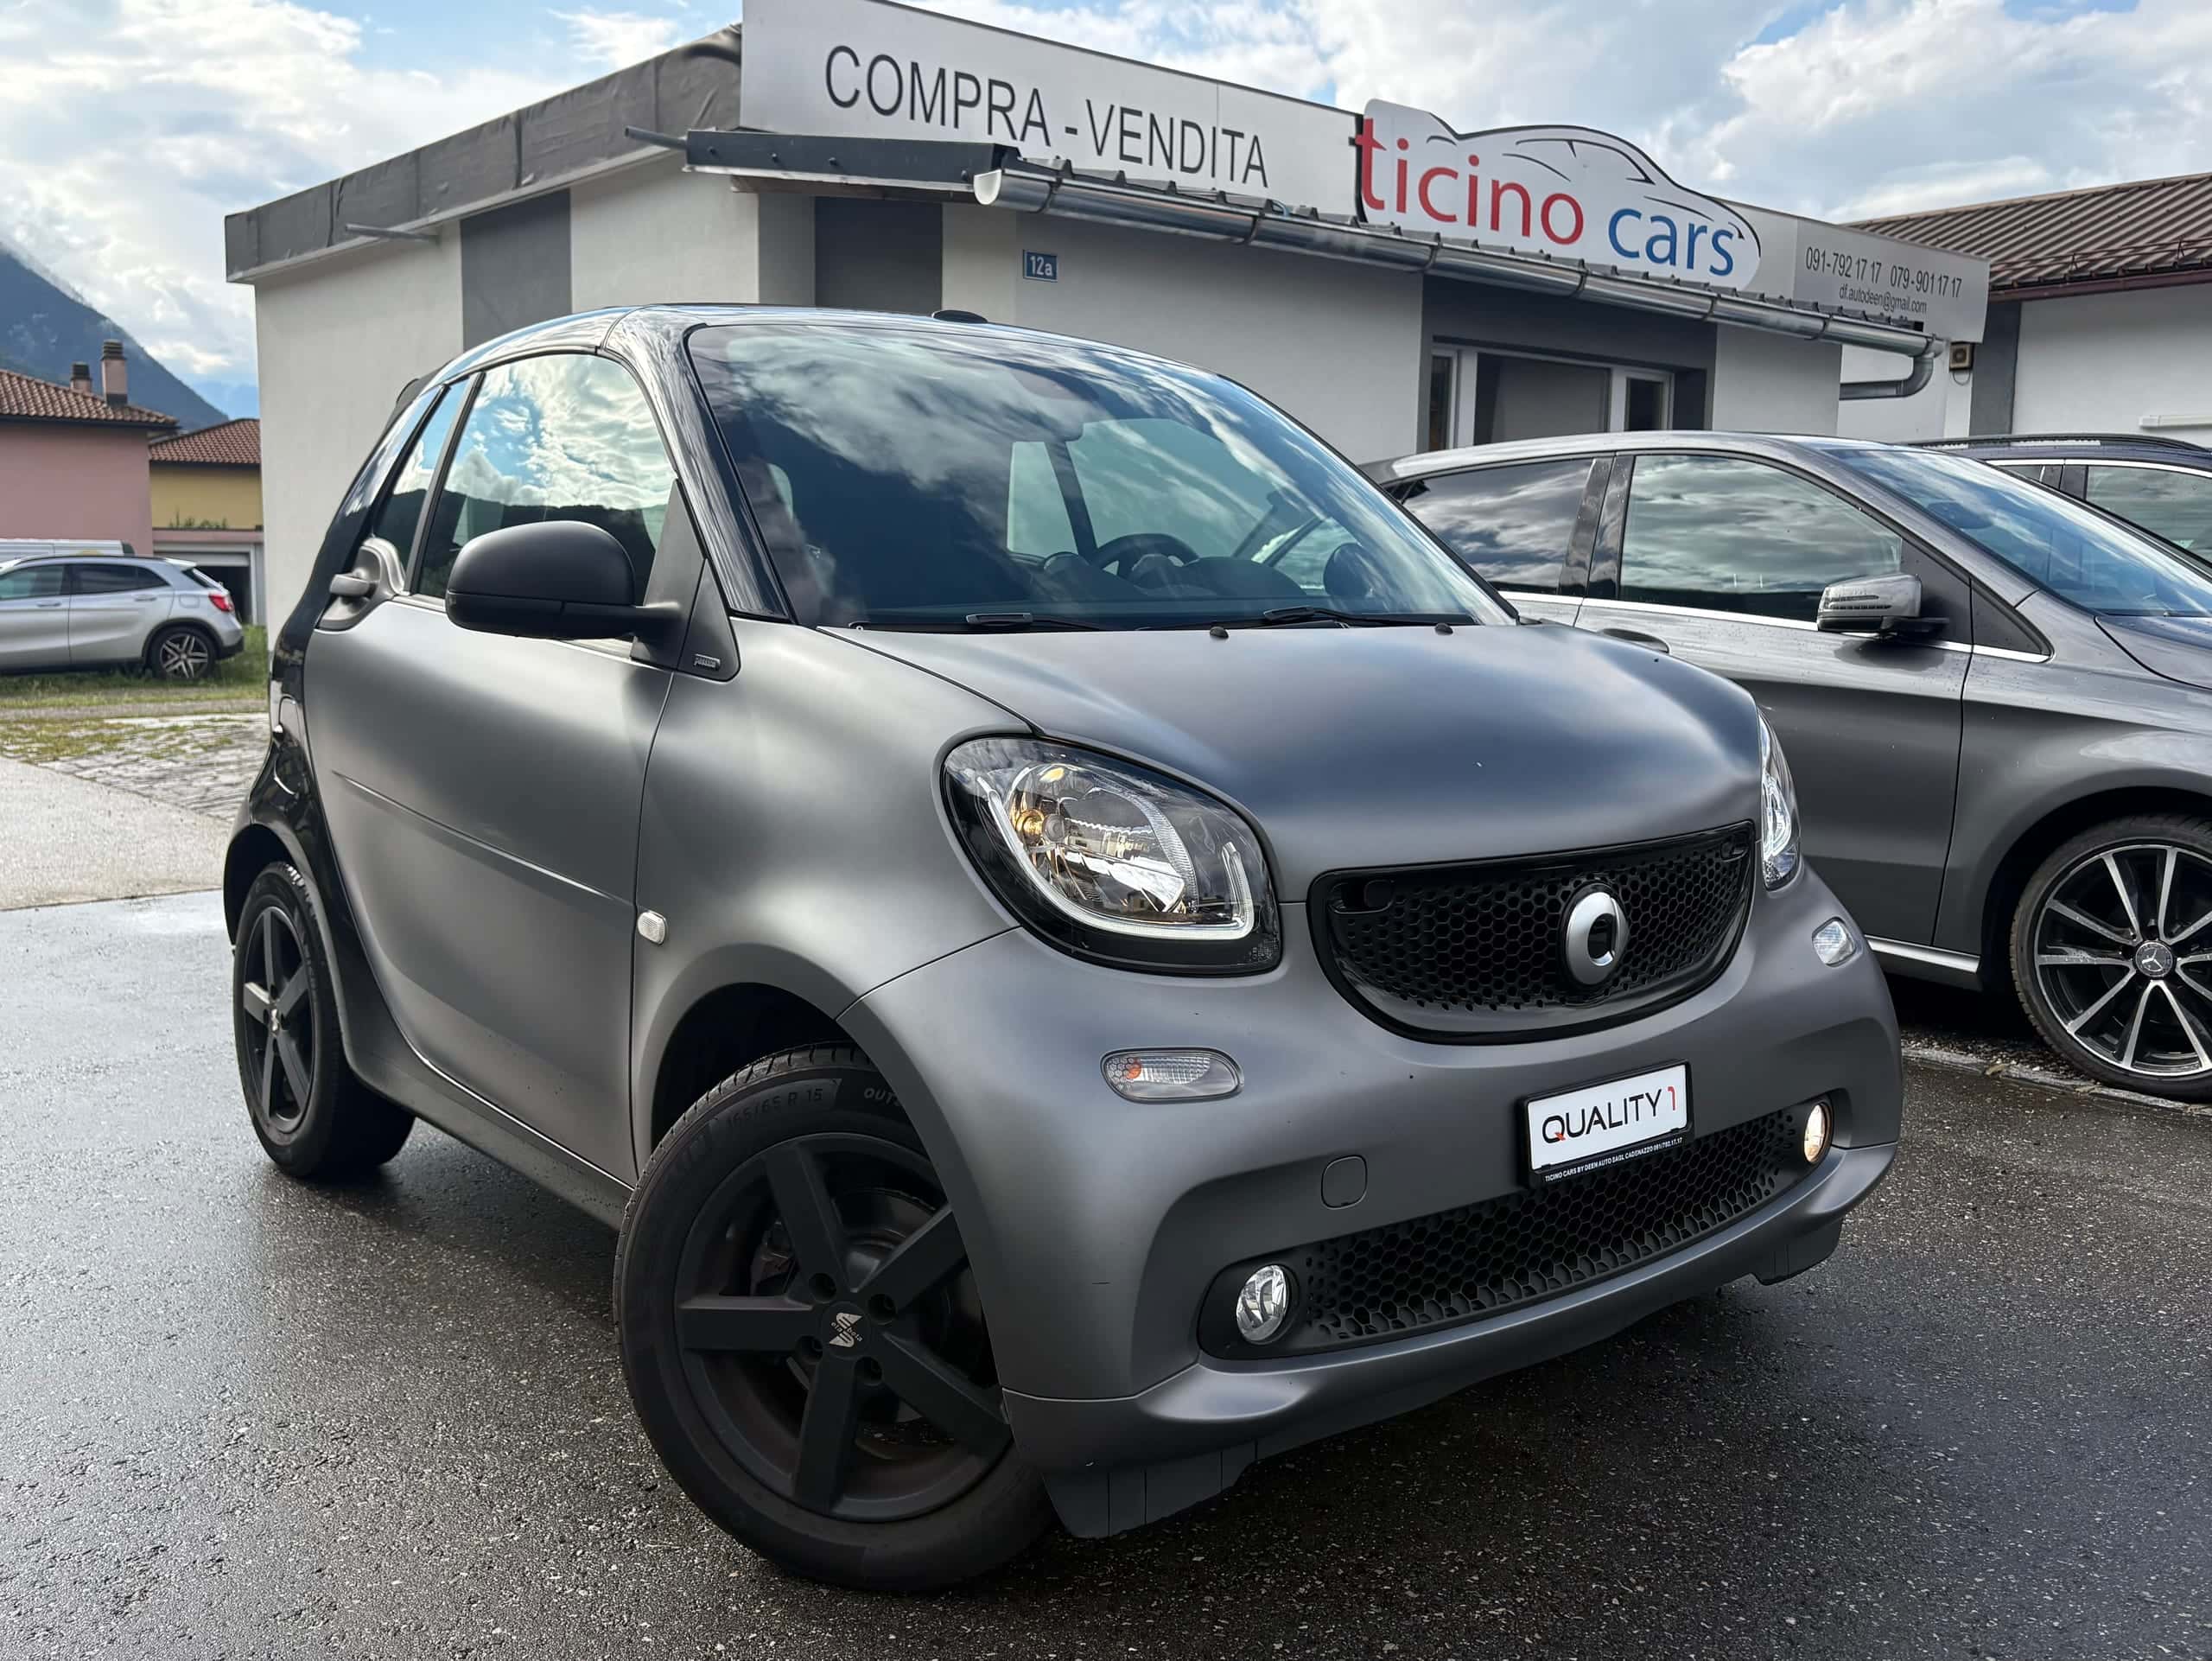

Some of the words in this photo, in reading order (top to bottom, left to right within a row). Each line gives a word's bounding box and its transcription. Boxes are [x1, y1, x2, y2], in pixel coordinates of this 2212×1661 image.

[825, 45, 1051, 147] COMPRA
[1355, 118, 1584, 245] ticino
[1608, 207, 1734, 277] cars
[1030, 255, 1053, 277] 12a
[1806, 246, 1853, 278] 091-792
[1855, 258, 1867, 282] 17
[1871, 261, 1882, 284] 17
[1541, 1089, 1662, 1144] QUALITY
[1668, 1085, 1676, 1111] 1
[1544, 1171, 1562, 1182] TICINO
[1562, 1168, 1577, 1177] CARS
[1599, 1157, 1612, 1168] AUTO
